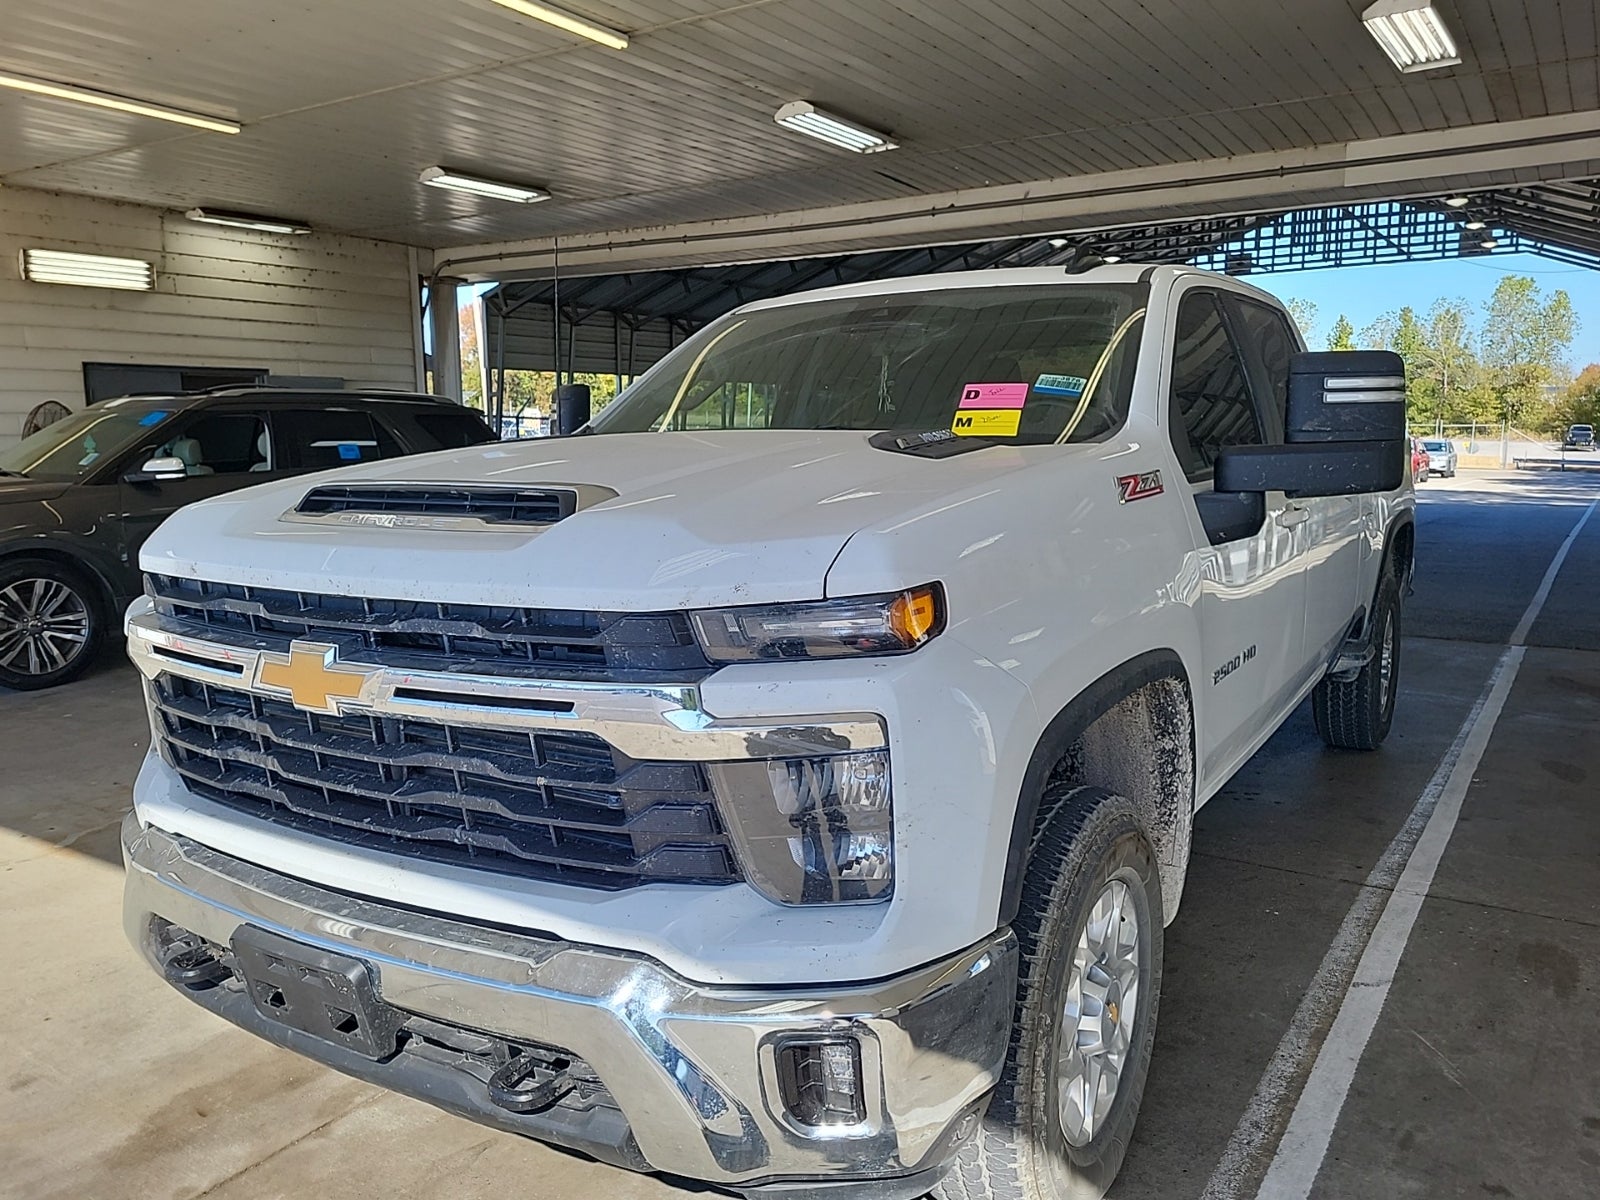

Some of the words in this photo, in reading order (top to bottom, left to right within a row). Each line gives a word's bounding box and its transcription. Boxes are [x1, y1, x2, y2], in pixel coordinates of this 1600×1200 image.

[964, 389, 981, 400] D
[955, 417, 973, 428] M
[1113, 469, 1165, 504] Z71
[1213, 655, 1241, 686] 2500
[1242, 644, 1257, 664] HD
